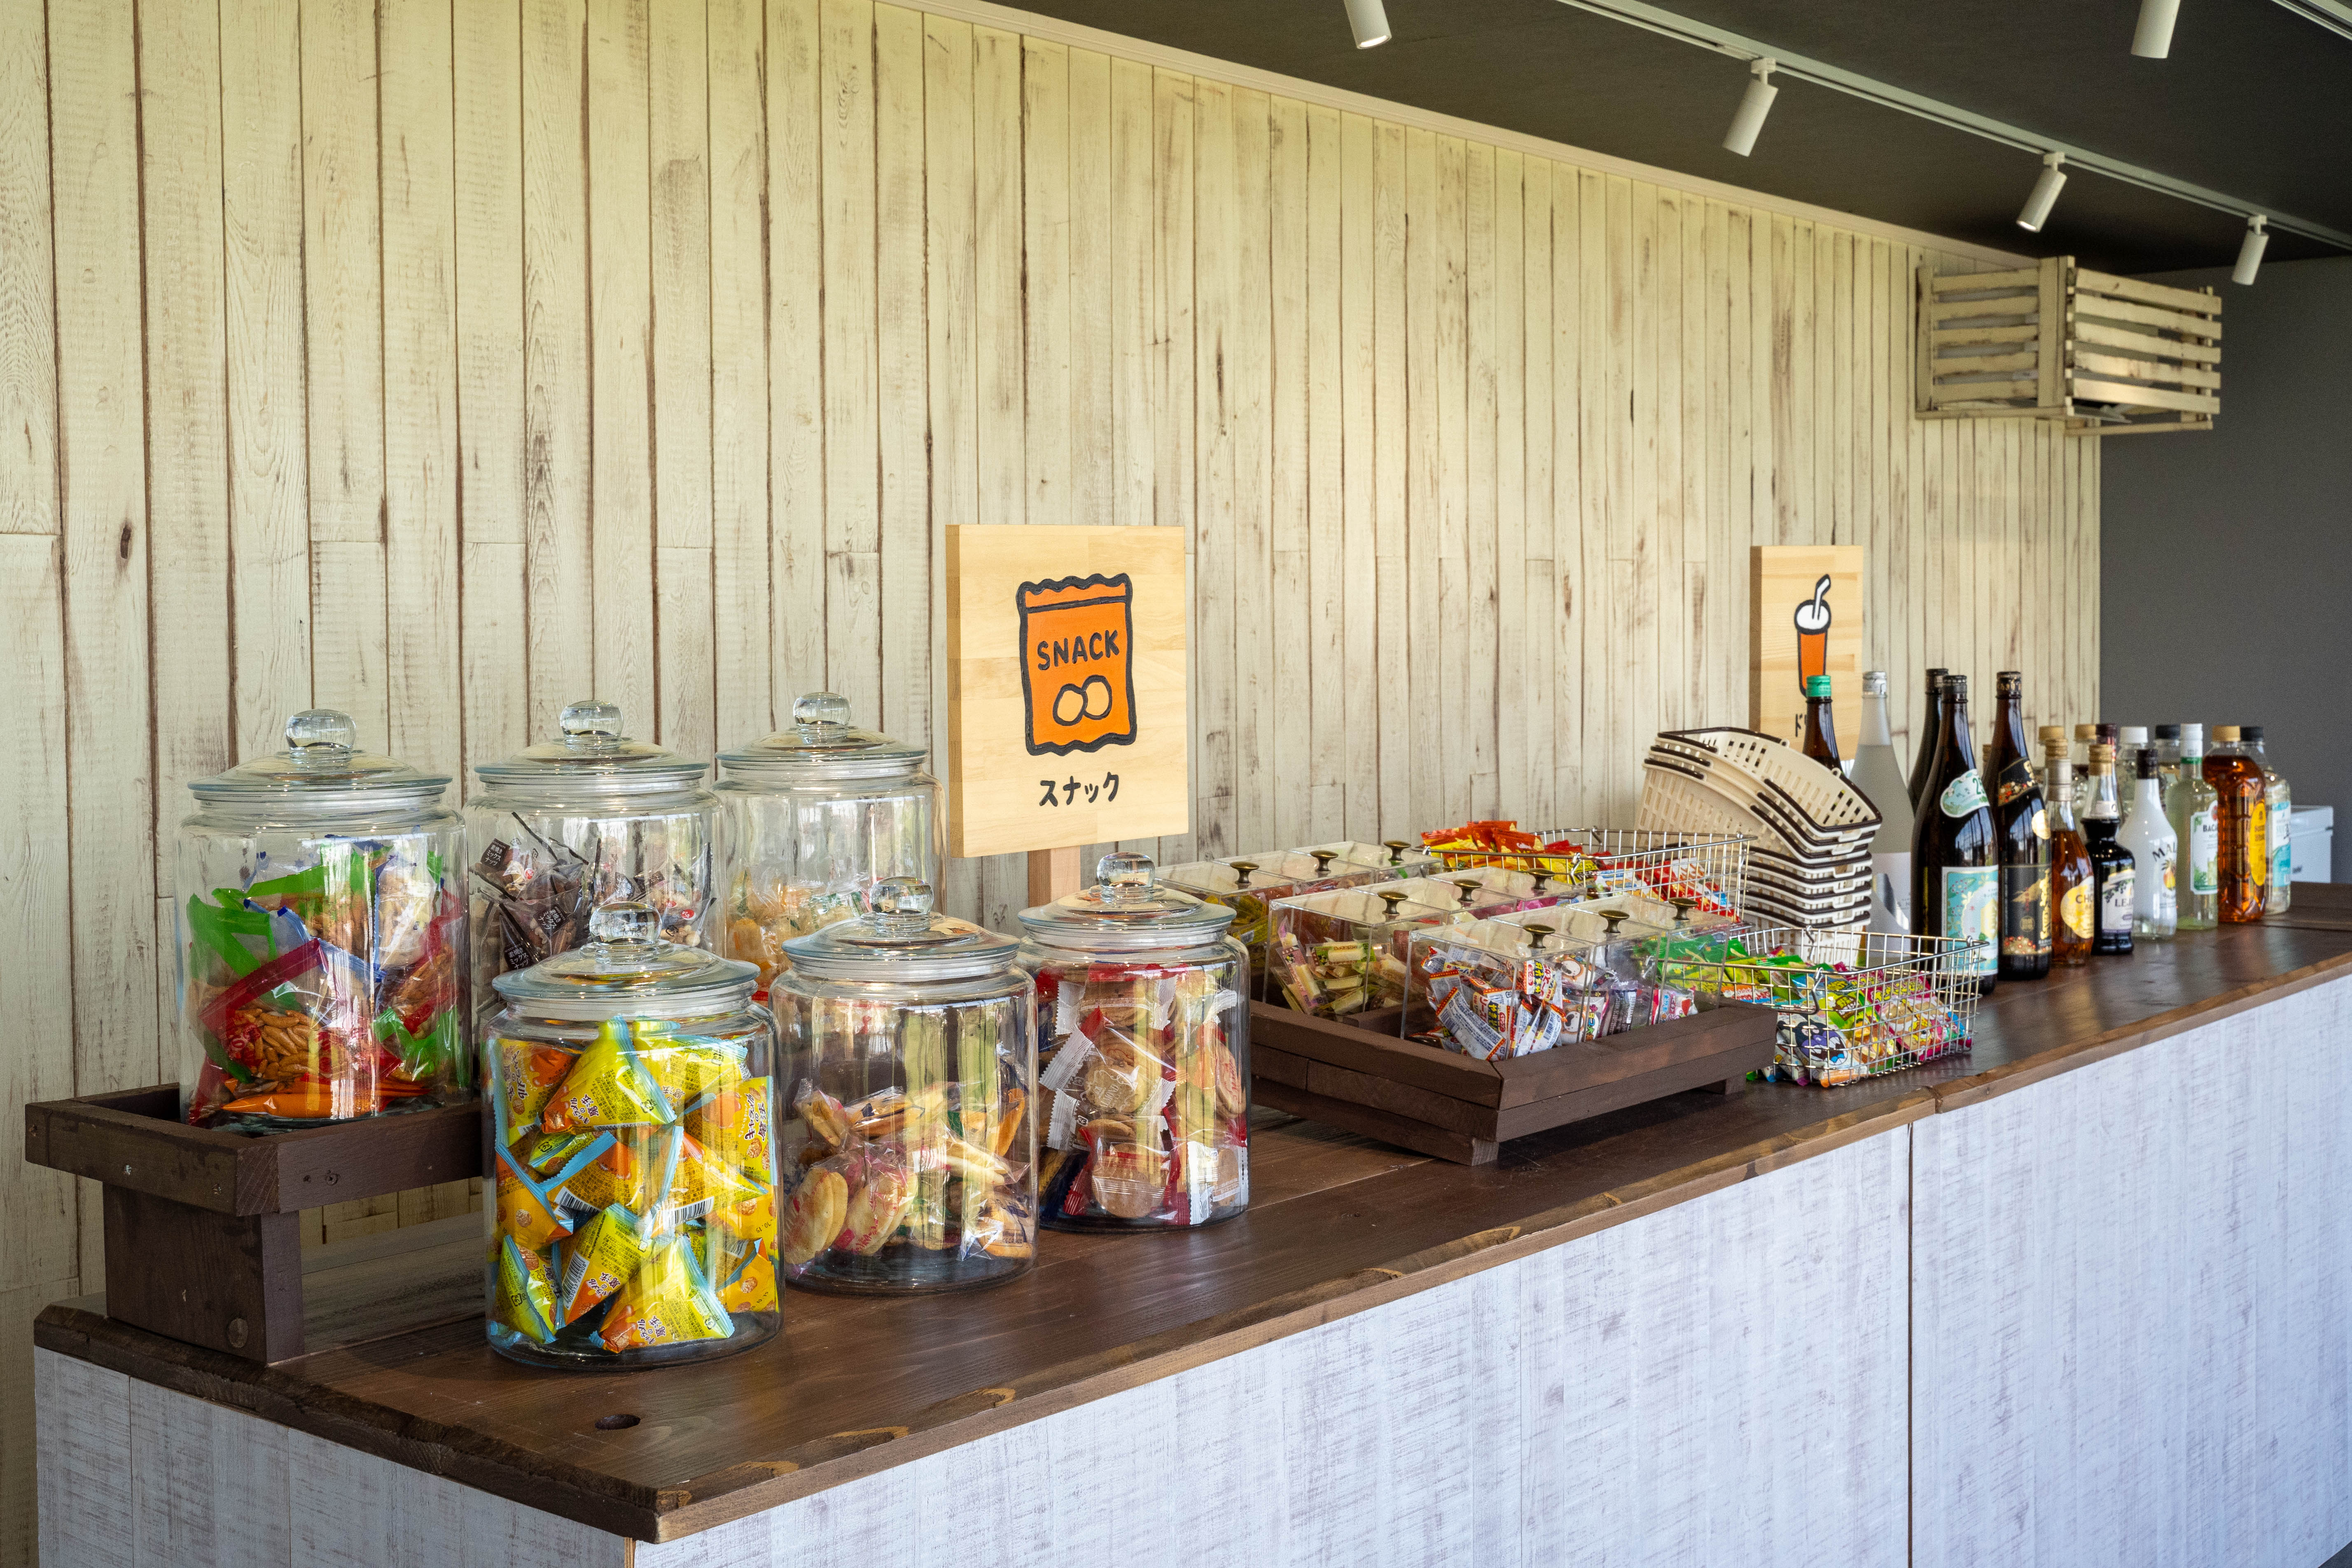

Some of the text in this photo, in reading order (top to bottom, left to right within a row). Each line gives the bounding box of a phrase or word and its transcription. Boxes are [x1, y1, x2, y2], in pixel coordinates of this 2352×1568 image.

[1037, 629, 1120, 671] SNACK
[1795, 714, 1807, 737] ド
[1039, 771, 1119, 807] スナック
[2203, 824, 2218, 832] BAC
[487, 850, 501, 862] ミックス
[490, 844, 503, 854] 素焼き
[2152, 841, 2176, 862] MAL
[485, 857, 498, 866] ナッツ
[538, 916, 551, 929] ナッツ
[544, 911, 557, 929] ミックス
[549, 909, 561, 923] 素焼き
[508, 947, 523, 958] 素焼き
[509, 952, 529, 964] ミックス
[514, 959, 528, 969] ナッツ
[512, 1050, 529, 1100] キャラメル
[570, 1097, 589, 1124] キャラメル
[581, 1094, 599, 1117] 魔法
[745, 1093, 756, 1140] キャラメル
[757, 1102, 767, 1142] 魔法
[565, 1136, 594, 1157] POPCORN
[535, 1269, 551, 1302] POPCORN
[539, 1269, 555, 1299] CARAMEL
[589, 1278, 613, 1296] キャラメル
[599, 1272, 621, 1289] 魔法
[638, 1319, 656, 1344] キャラメル
[649, 1315, 666, 1337] 魔法
